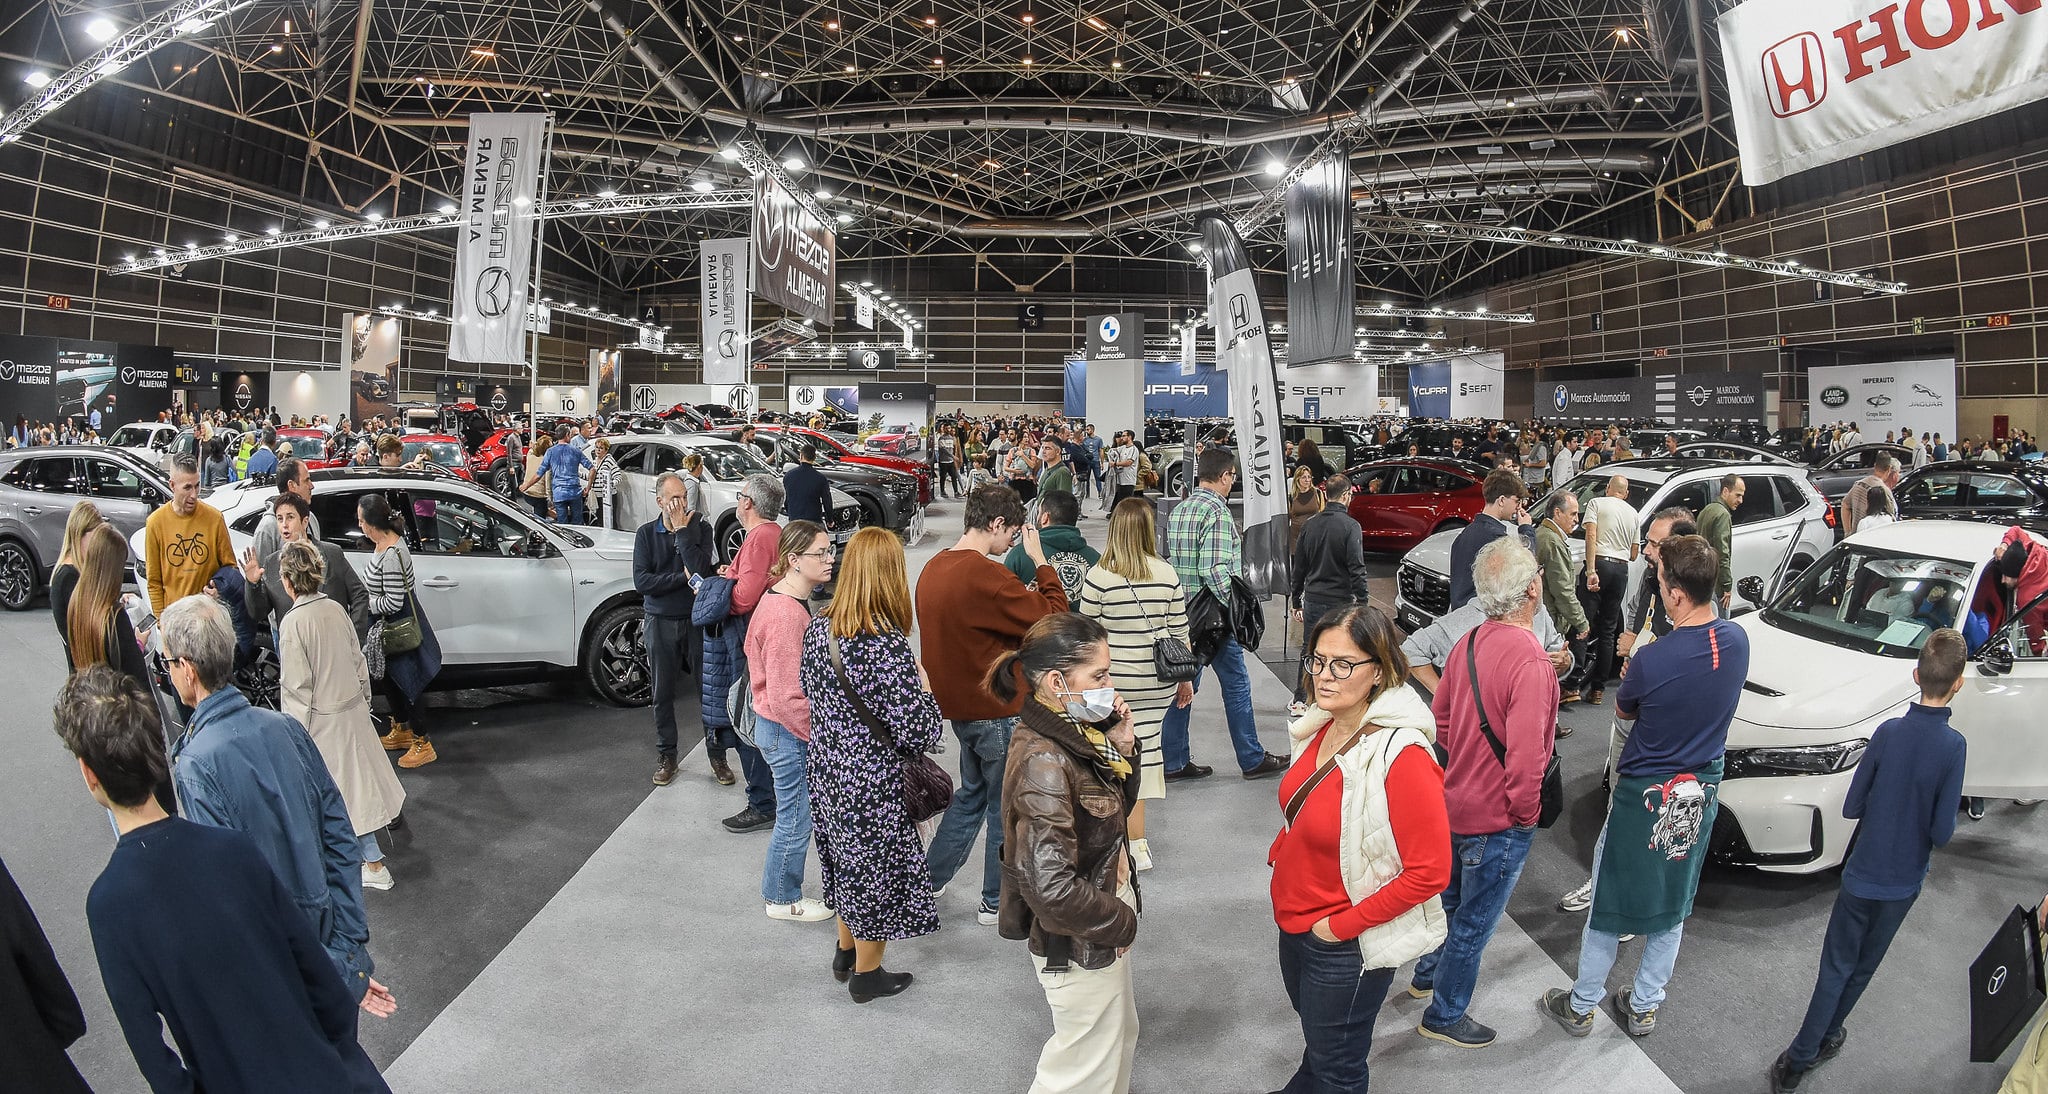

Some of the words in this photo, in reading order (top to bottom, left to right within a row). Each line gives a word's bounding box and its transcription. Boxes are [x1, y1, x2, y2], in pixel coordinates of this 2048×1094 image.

[785, 219, 830, 276] mazda
[1291, 237, 1347, 283] TESLA
[786, 264, 827, 310] ALMENAR
[646, 307, 655, 319] A
[1026, 305, 1036, 317] C
[641, 335, 663, 347] NISSAN
[864, 353, 879, 367] MG
[16, 364, 51, 374] mazda
[137, 370, 168, 379] mazda
[18, 375, 50, 385] ALMENAR
[138, 380, 167, 388] ALMENAR
[1292, 387, 1346, 396] SEAT
[1418, 386, 1448, 395] CUPRA
[1468, 384, 1493, 393] SEAT
[1716, 386, 1740, 394] MARCOS
[635, 387, 655, 410] MG
[798, 388, 813, 404] MG
[882, 393, 903, 401] CX-5
[1570, 392, 1592, 403] Marcos
[1593, 391, 1631, 403] Automoción
[1716, 394, 1755, 404] AUTOMOCIÓN
[1826, 396, 1845, 404] ROVER
[561, 399, 575, 411] 10
